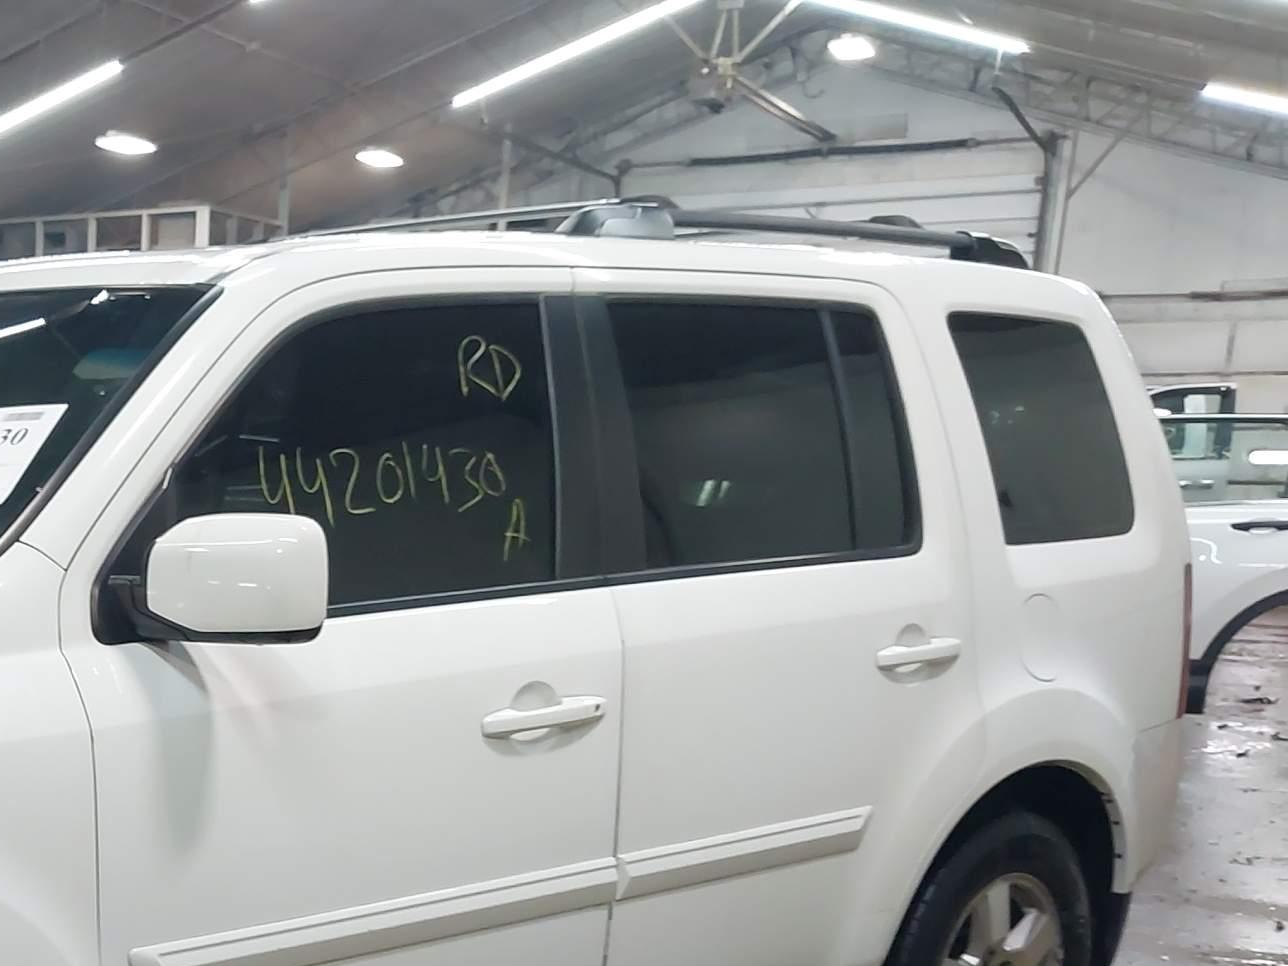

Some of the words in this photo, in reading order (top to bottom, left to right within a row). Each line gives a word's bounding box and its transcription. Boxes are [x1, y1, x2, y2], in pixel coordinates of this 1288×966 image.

[457, 335, 521, 401] RD
[259, 441, 506, 527] 44201430
[503, 498, 530, 561] A
